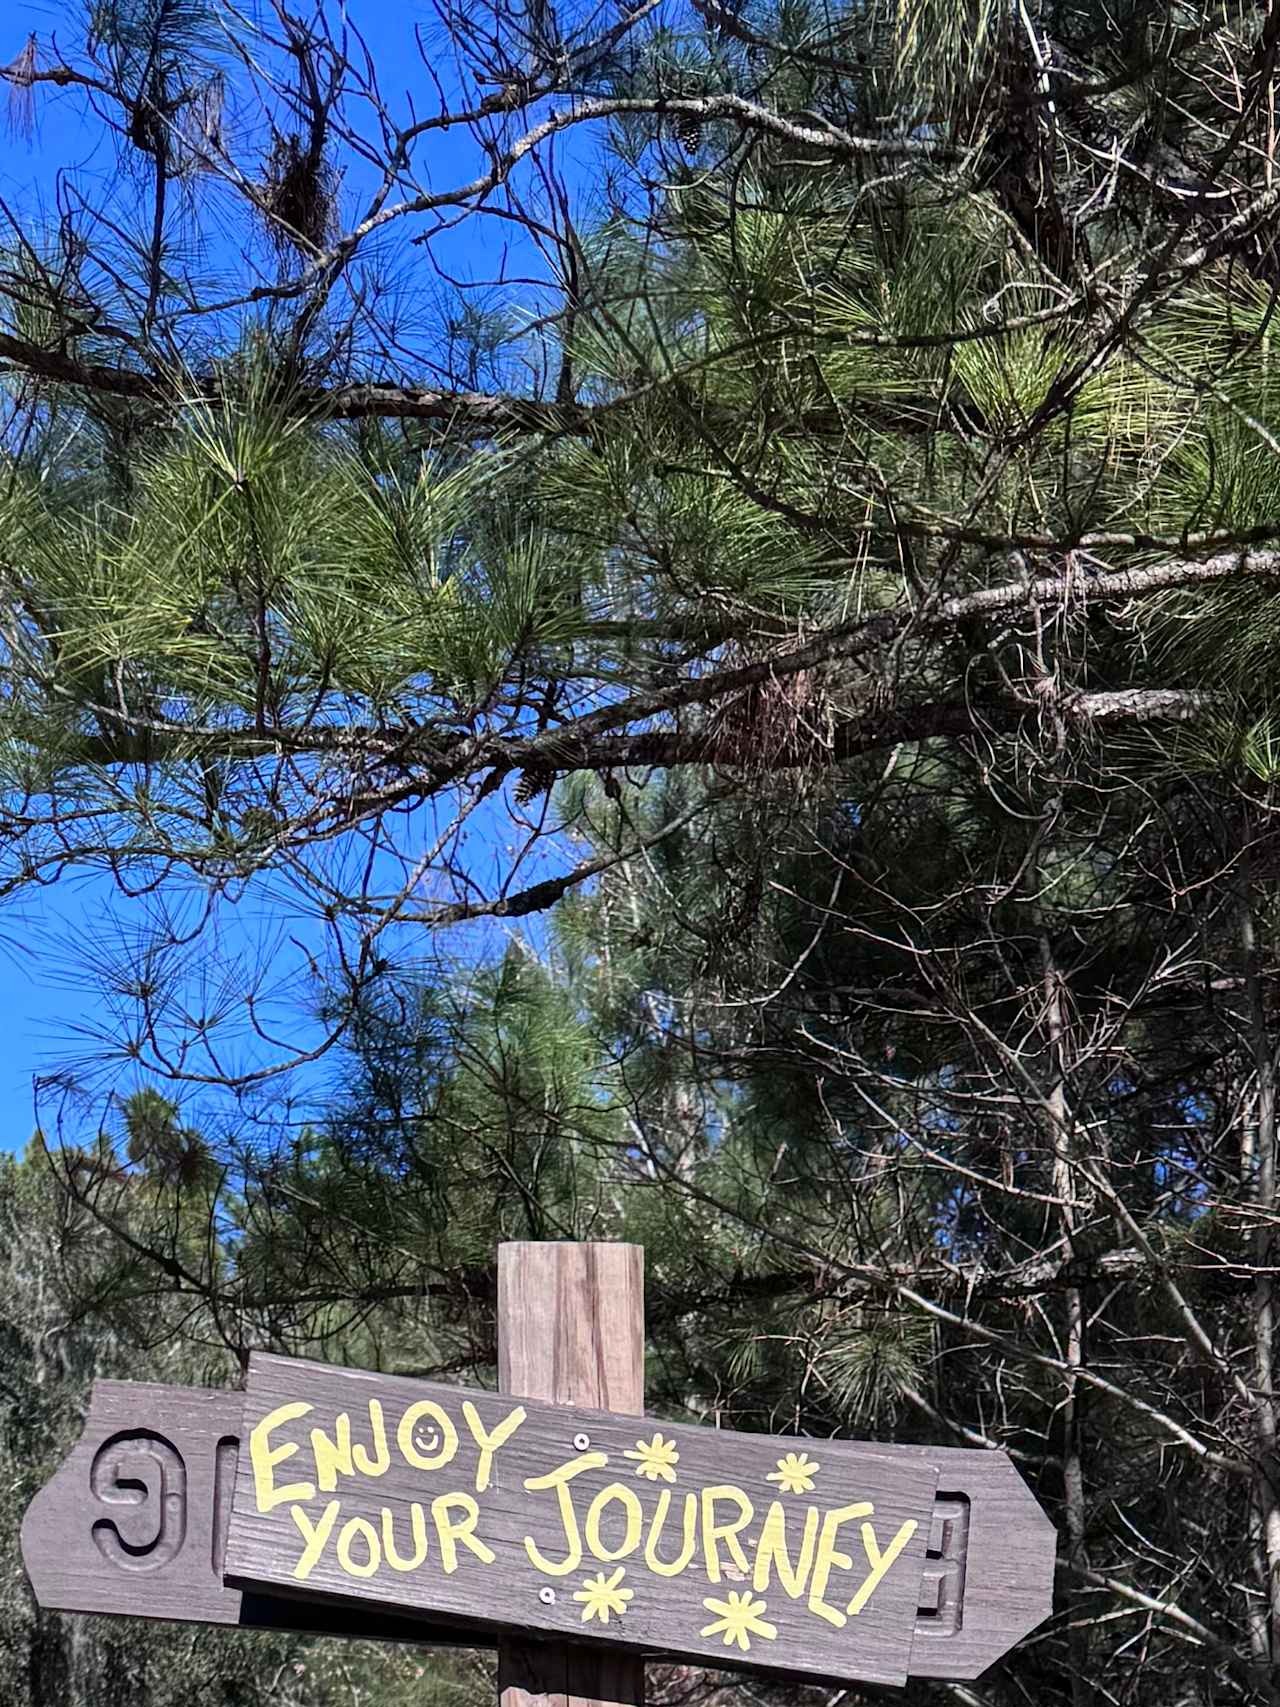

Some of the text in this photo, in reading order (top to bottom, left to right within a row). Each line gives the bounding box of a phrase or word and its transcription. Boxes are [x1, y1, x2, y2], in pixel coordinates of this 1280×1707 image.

[249, 1399, 526, 1513] ENJOY
[290, 1489, 496, 1580] YOUR
[522, 1451, 917, 1629] JOURNEY
